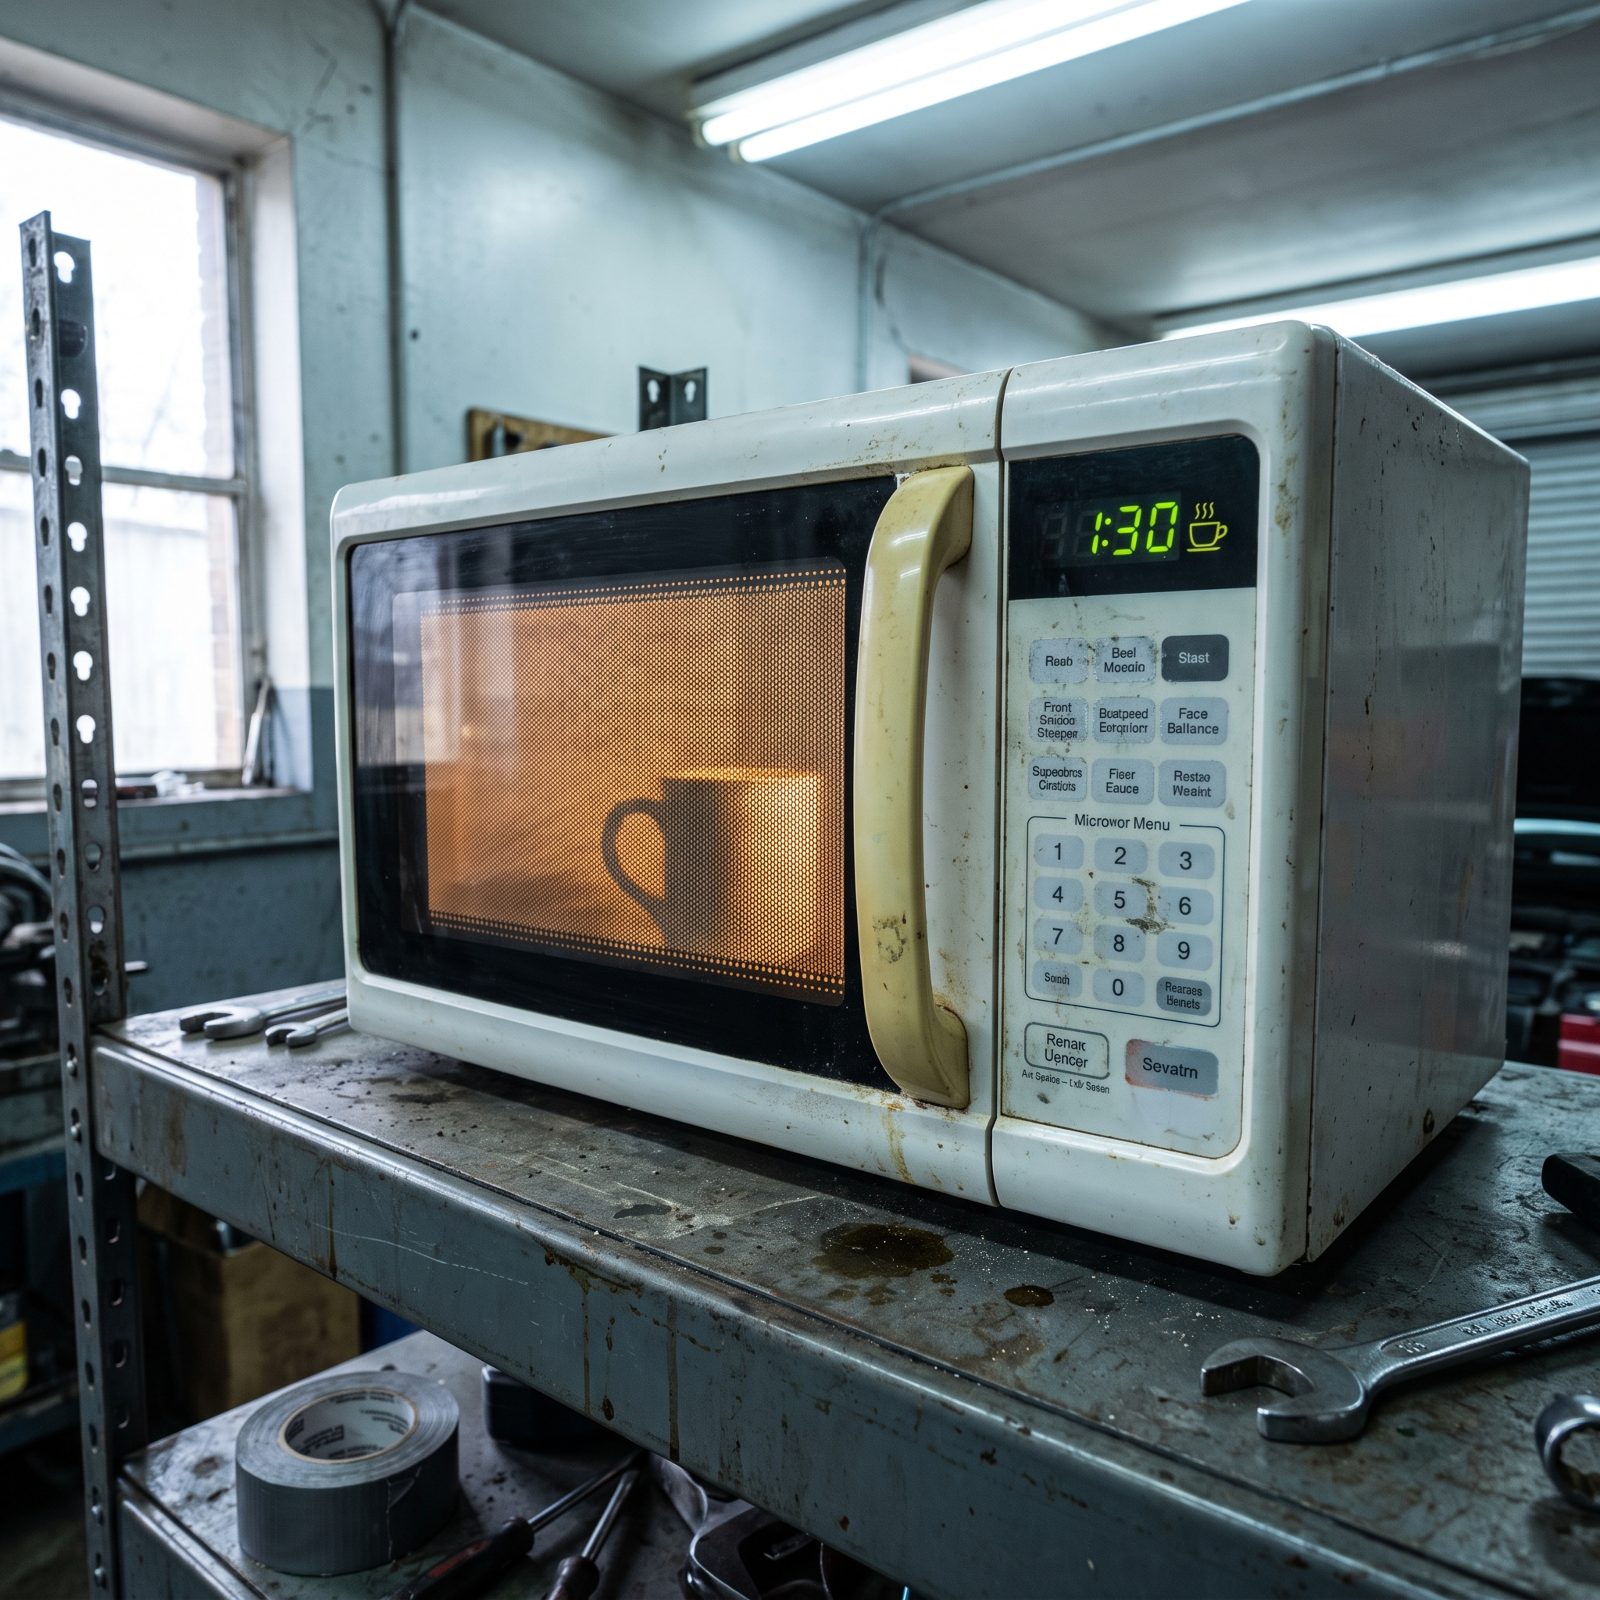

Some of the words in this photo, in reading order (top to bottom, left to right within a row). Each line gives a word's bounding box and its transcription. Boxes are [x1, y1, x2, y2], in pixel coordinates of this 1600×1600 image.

[1091, 501, 1178, 556] 1:30
[1044, 701, 1072, 712] Front
[1179, 707, 1208, 720] Face
[1167, 722, 1219, 735] Ballance
[1105, 782, 1139, 794] Eauce
[1074, 813, 1130, 829] Microwor
[1133, 816, 1170, 831] Menu
[1054, 842, 1061, 860] 1
[1114, 847, 1127, 865] 2
[1179, 851, 1192, 870] 3
[1052, 885, 1064, 903] 4
[1114, 890, 1126, 909] 5
[1178, 896, 1192, 915] 6
[1052, 927, 1064, 945] 7
[1113, 934, 1125, 952] 8
[1177, 941, 1190, 960] 9
[1112, 978, 1124, 996] 0
